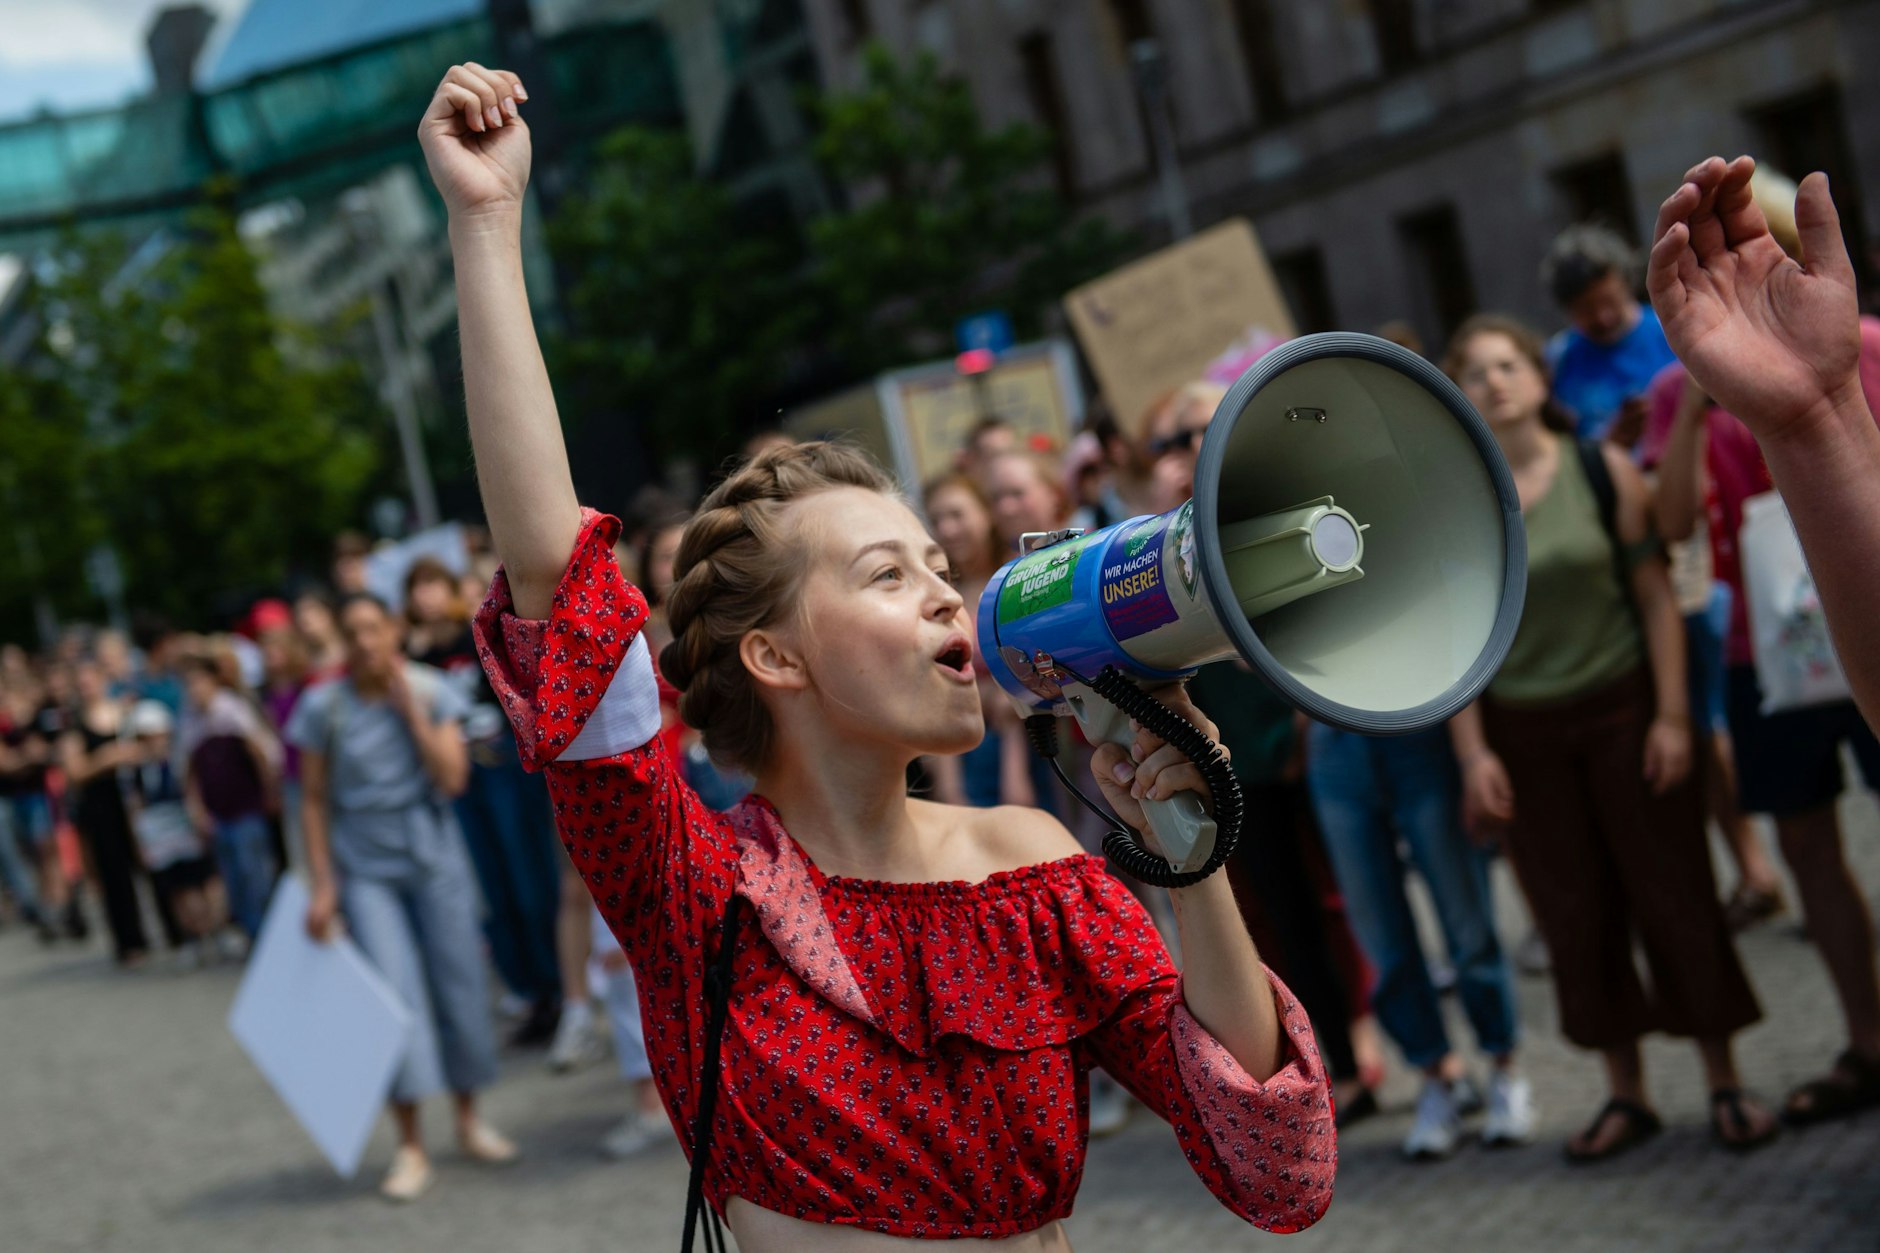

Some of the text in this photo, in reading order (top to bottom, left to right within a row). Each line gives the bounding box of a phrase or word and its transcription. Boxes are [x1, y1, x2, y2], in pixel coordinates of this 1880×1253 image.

[1021, 564, 1069, 596] JUGEND
[1104, 547, 1159, 580] WIR MACHEN
[1103, 564, 1160, 604] UNSERE!
